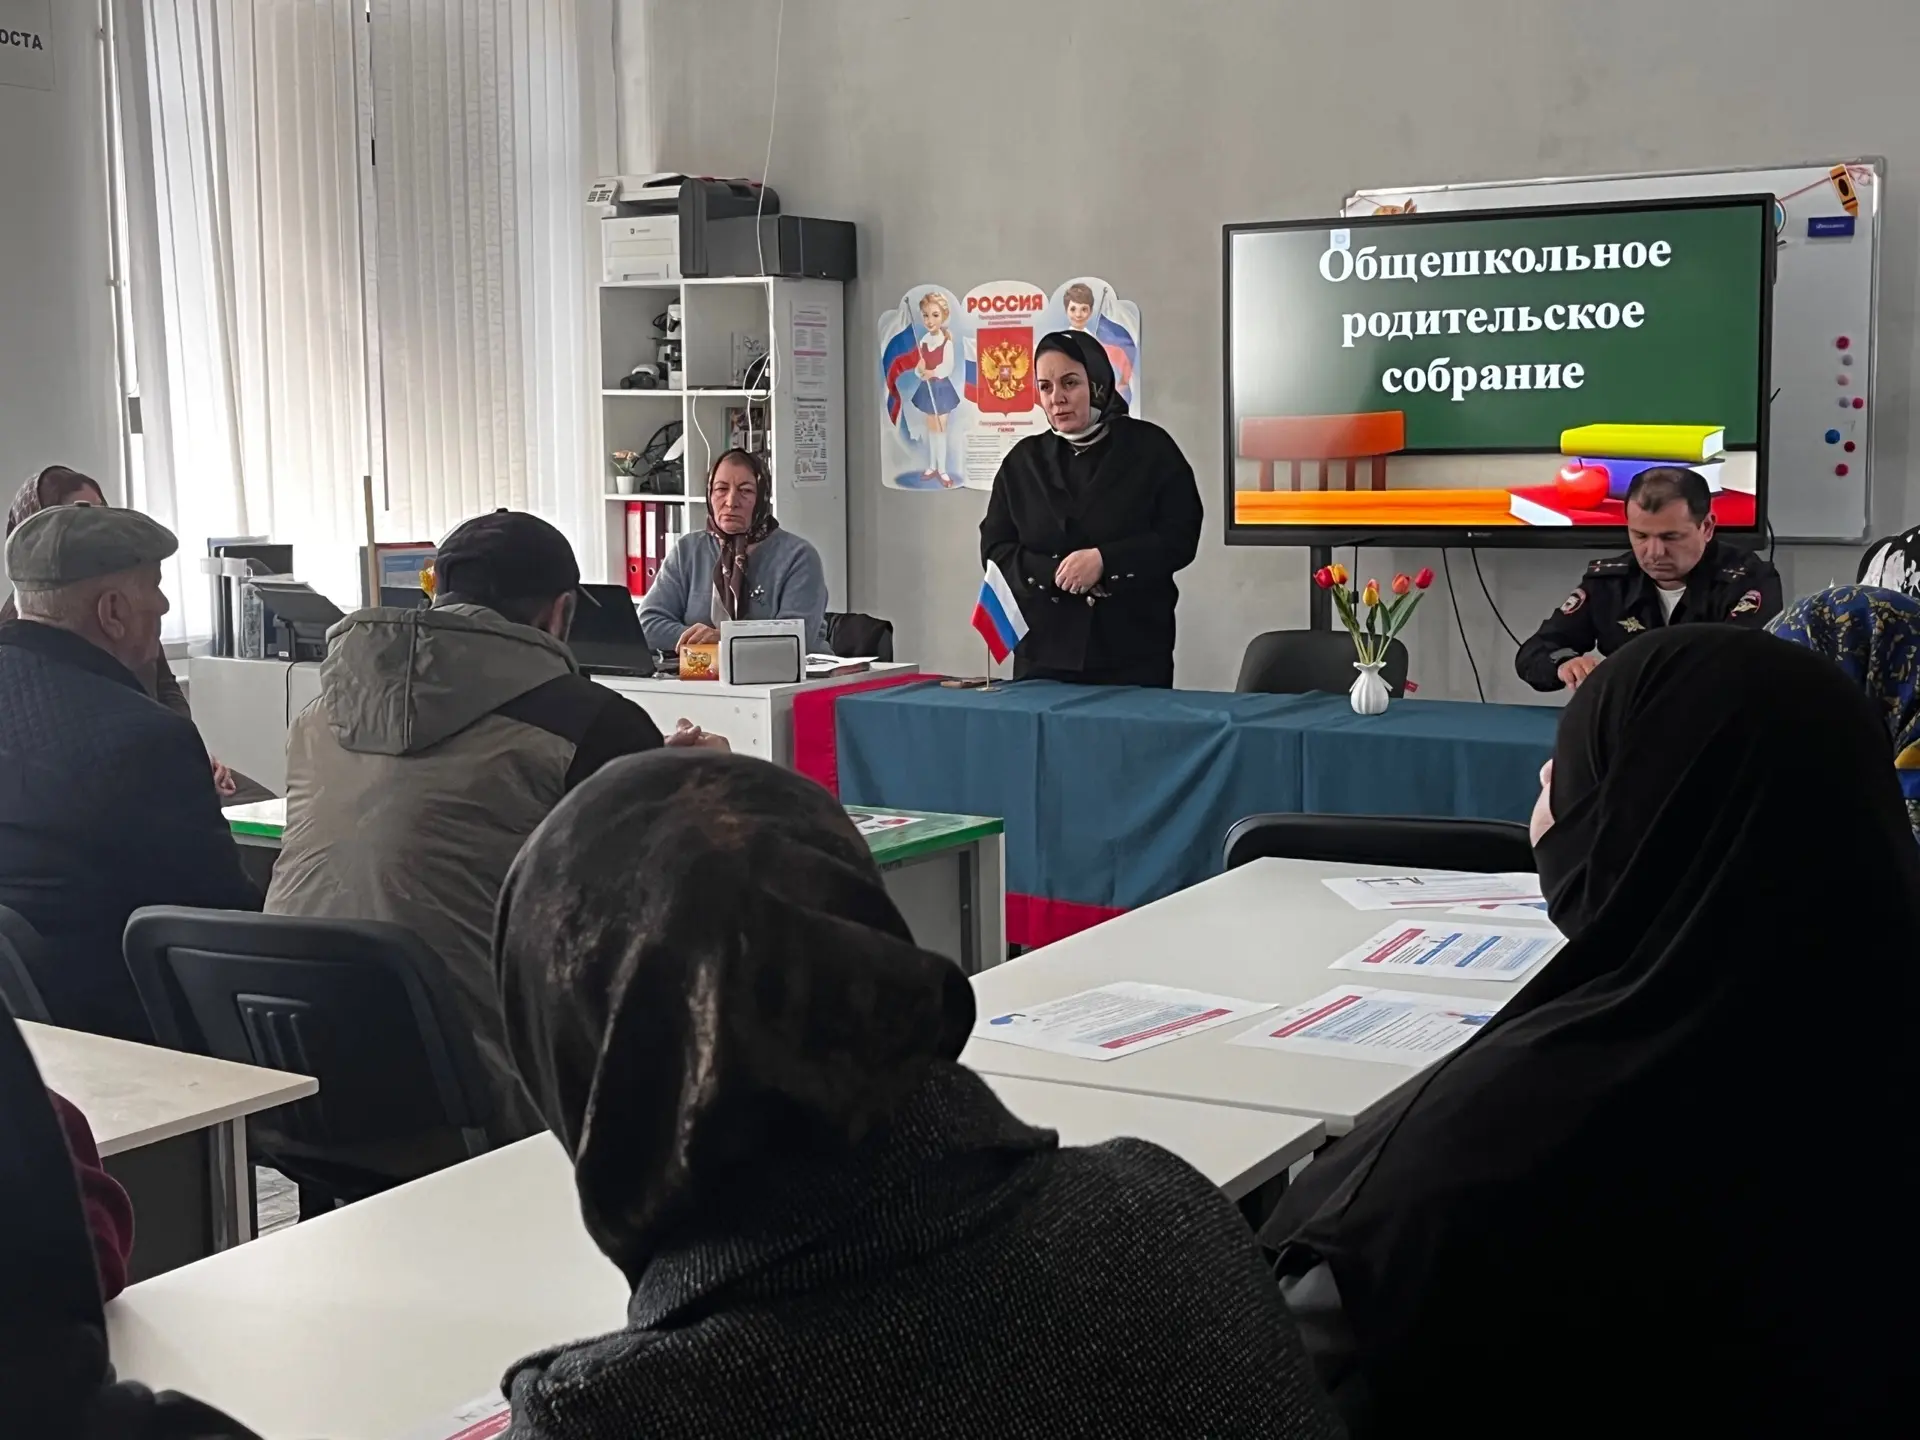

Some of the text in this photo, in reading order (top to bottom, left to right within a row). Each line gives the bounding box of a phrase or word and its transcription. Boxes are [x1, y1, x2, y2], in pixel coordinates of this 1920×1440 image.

[1319, 239, 1672, 282] Общешкольное
[967, 294, 1043, 313] РОССИЯ
[1342, 301, 1645, 347] родительское
[1382, 357, 1585, 401] собрание
